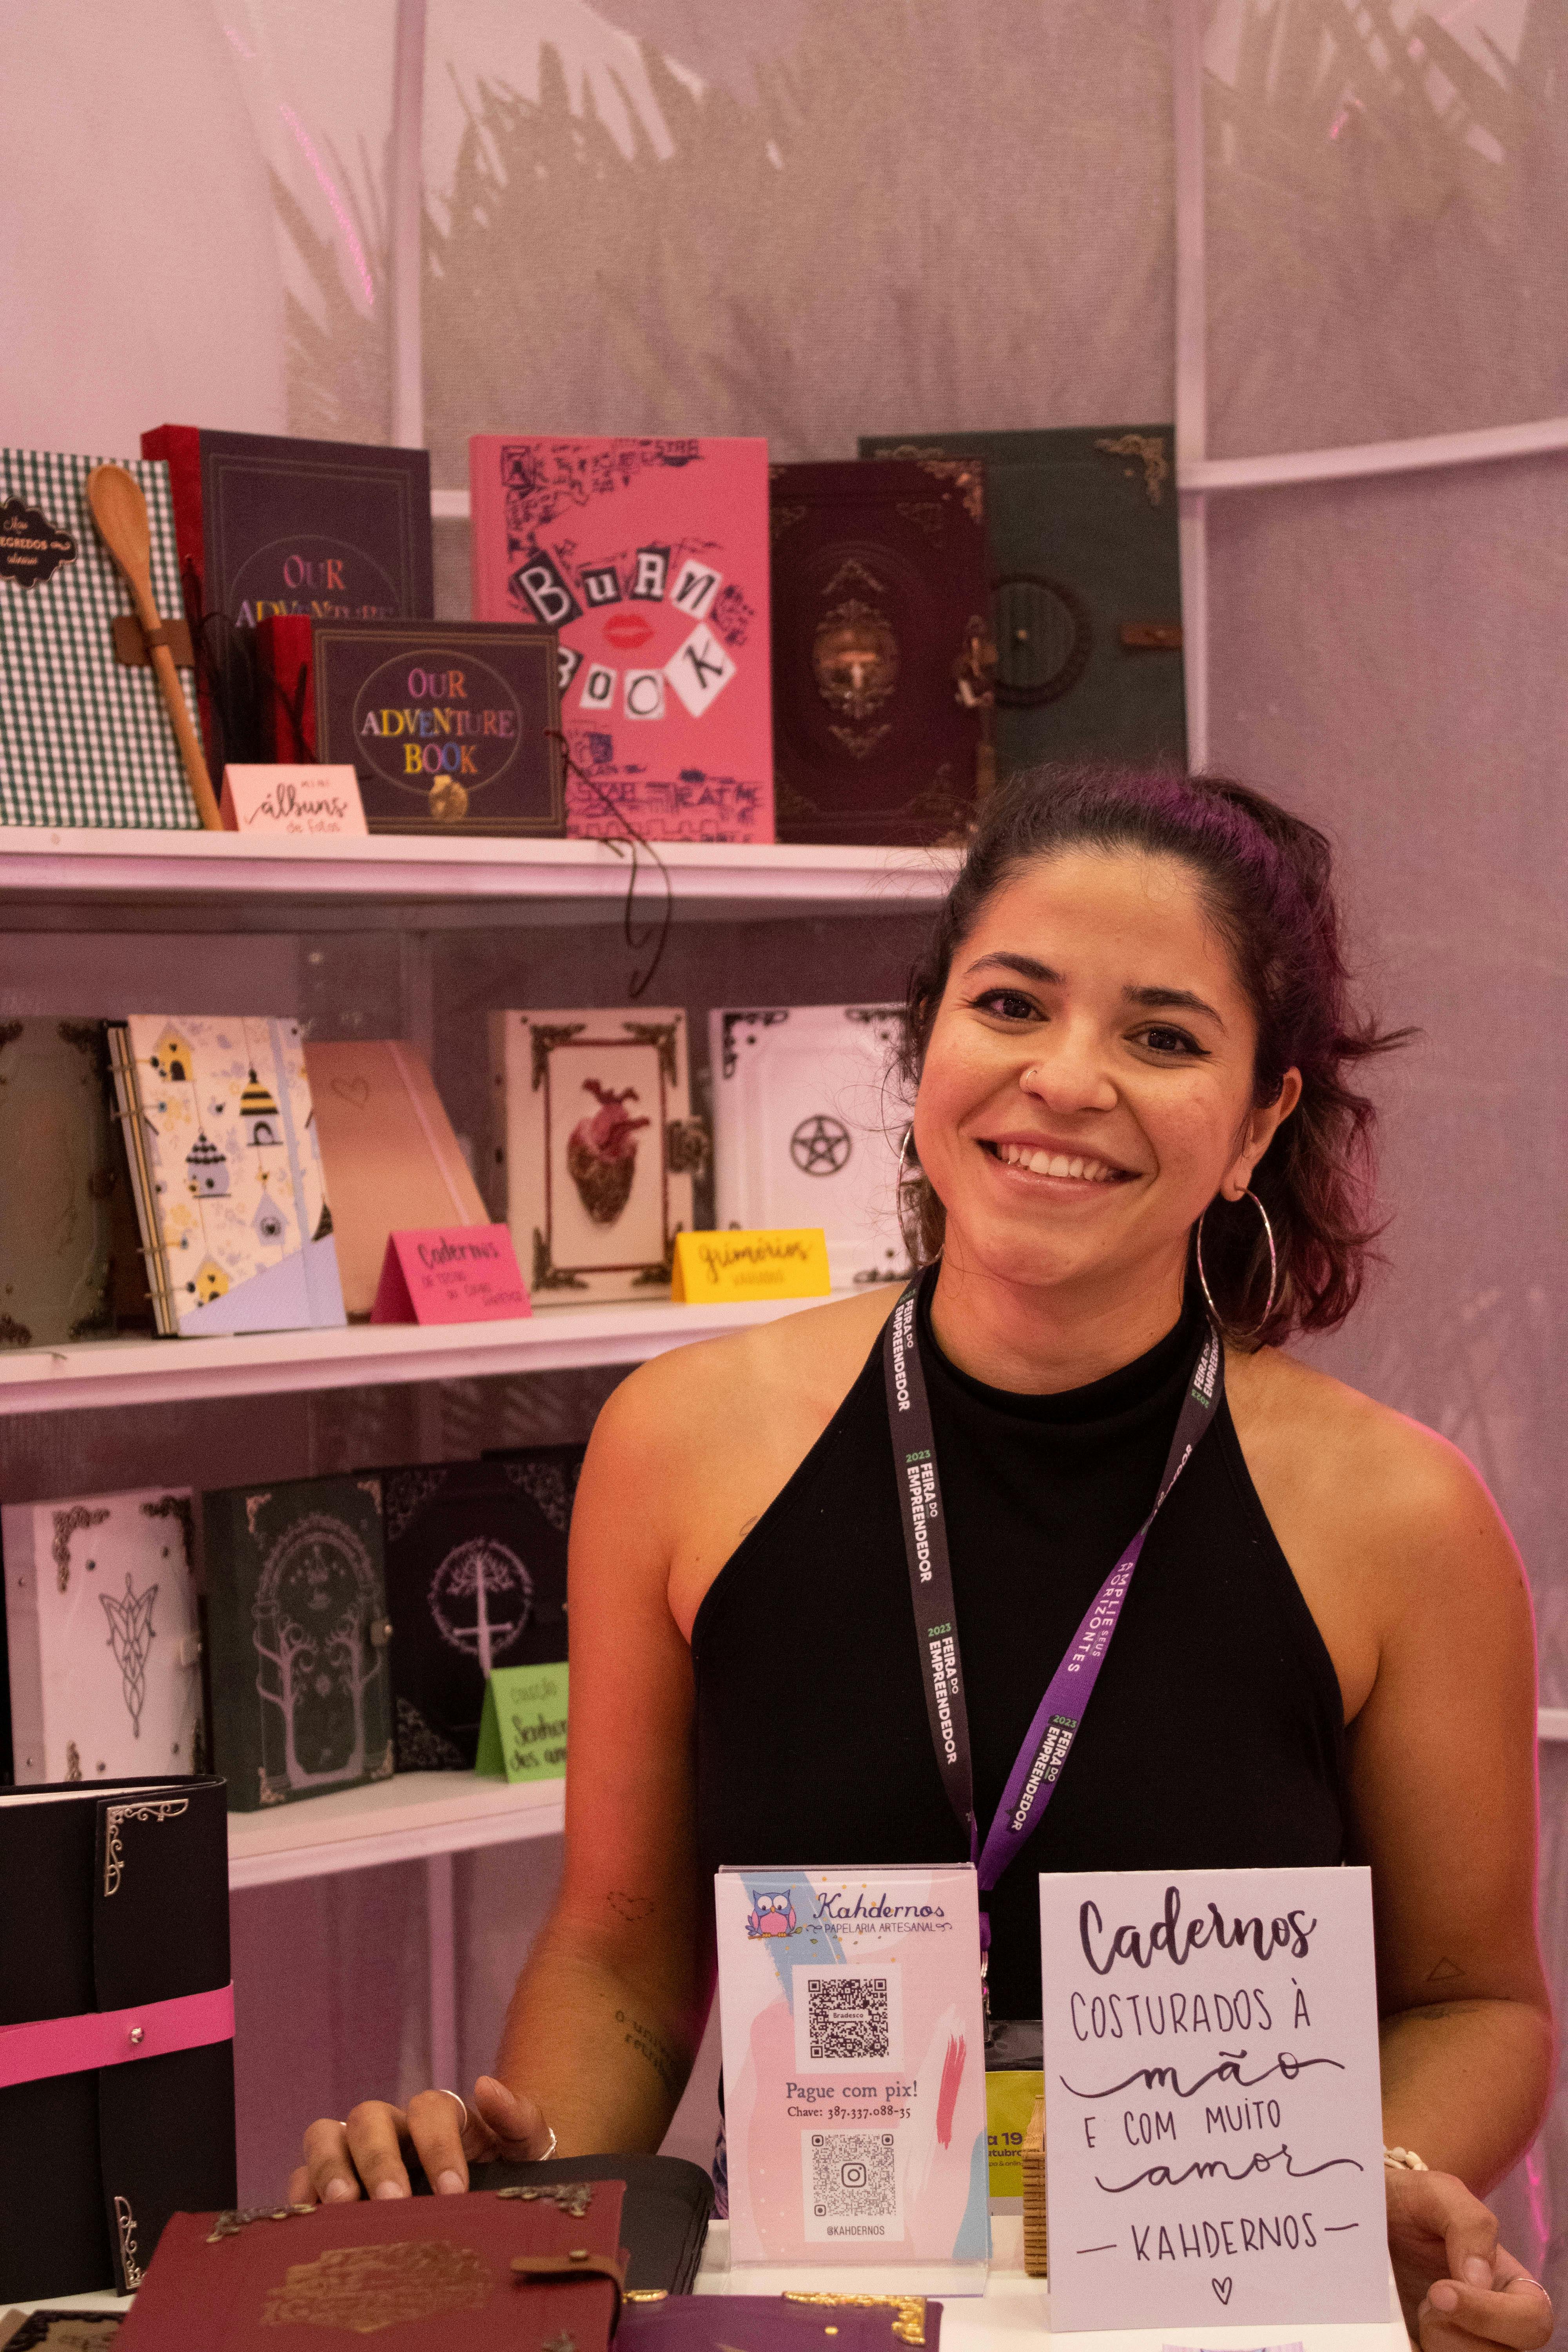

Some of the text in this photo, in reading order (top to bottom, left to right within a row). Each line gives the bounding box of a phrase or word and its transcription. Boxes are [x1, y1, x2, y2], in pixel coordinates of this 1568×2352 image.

[284, 555, 345, 589] OUR
[408, 668, 468, 698] OUR
[361, 708, 515, 738] ADVENTURE
[404, 742, 478, 774] BOOK
[904, 1299, 914, 1348] FEIRA DO
[892, 1304, 911, 1412] EMPREENDEDOR
[906, 1450, 931, 1463] 2023
[920, 1463, 938, 1518] FEIRA DO
[907, 1466, 932, 1583] EMPREENDEDOR
[927, 1622, 952, 1637] 2023
[942, 1637, 959, 1694] FEIRA DO
[929, 1640, 957, 1765] EMPREENDEDOR
[1053, 1715, 1078, 1728] 2023
[1011, 1726, 1060, 1831] EMPREENDEDOR
[1048, 1730, 1073, 1782] FEIRA DO
[813, 1892, 945, 1919] Kahdernos
[825, 1922, 936, 1933] PAPELARIA ARTESANAL
[1080, 1886, 1317, 1975] Cadernos
[1071, 1978, 1310, 2041] COSTURADOS À
[786, 2080, 918, 2102] Pague com pix!
[1060, 2049, 1345, 2098] mão
[788, 2106, 822, 2117] Chave:
[1085, 2098, 1280, 2148] E COM MUITO
[1001, 2132, 1023, 2145] 19
[1095, 2144, 1363, 2193] amor
[827, 2226, 885, 2236] @KAHDERNOS
[1131, 2213, 1317, 2261] KAHDERNOS
